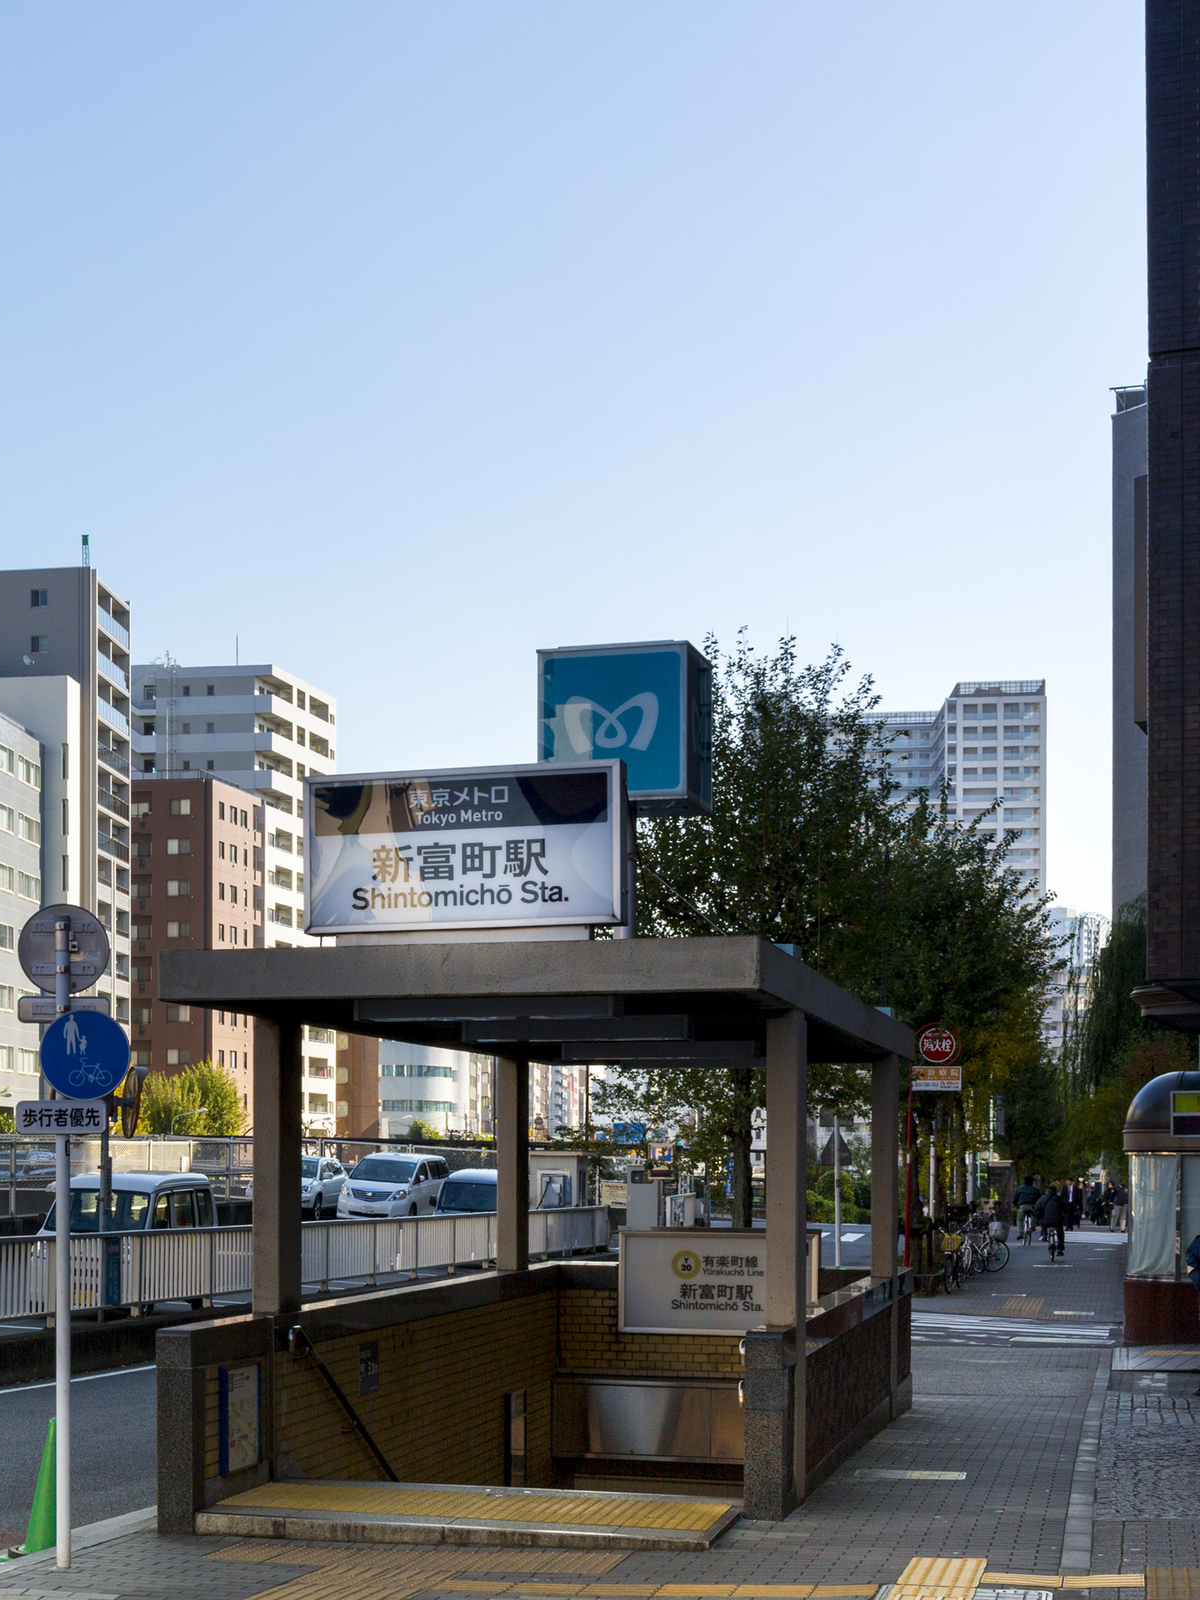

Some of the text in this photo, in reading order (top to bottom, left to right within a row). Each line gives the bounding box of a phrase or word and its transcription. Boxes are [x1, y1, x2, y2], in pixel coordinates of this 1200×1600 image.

[409, 786, 509, 809] 東京メトロ
[415, 809, 503, 827] Tokyo Metro
[371, 838, 549, 884] 新富町駅
[352, 880, 570, 911] Shintomichō Sta.
[22, 1108, 100, 1128] 歩行者優先
[680, 1264, 692, 1272] 20
[702, 1255, 759, 1269] 有楽町線
[702, 1268, 764, 1277] Yūrakuchō Line
[680, 1283, 754, 1301] 新富町駅
[671, 1299, 764, 1312] Shintomichō Sta.
